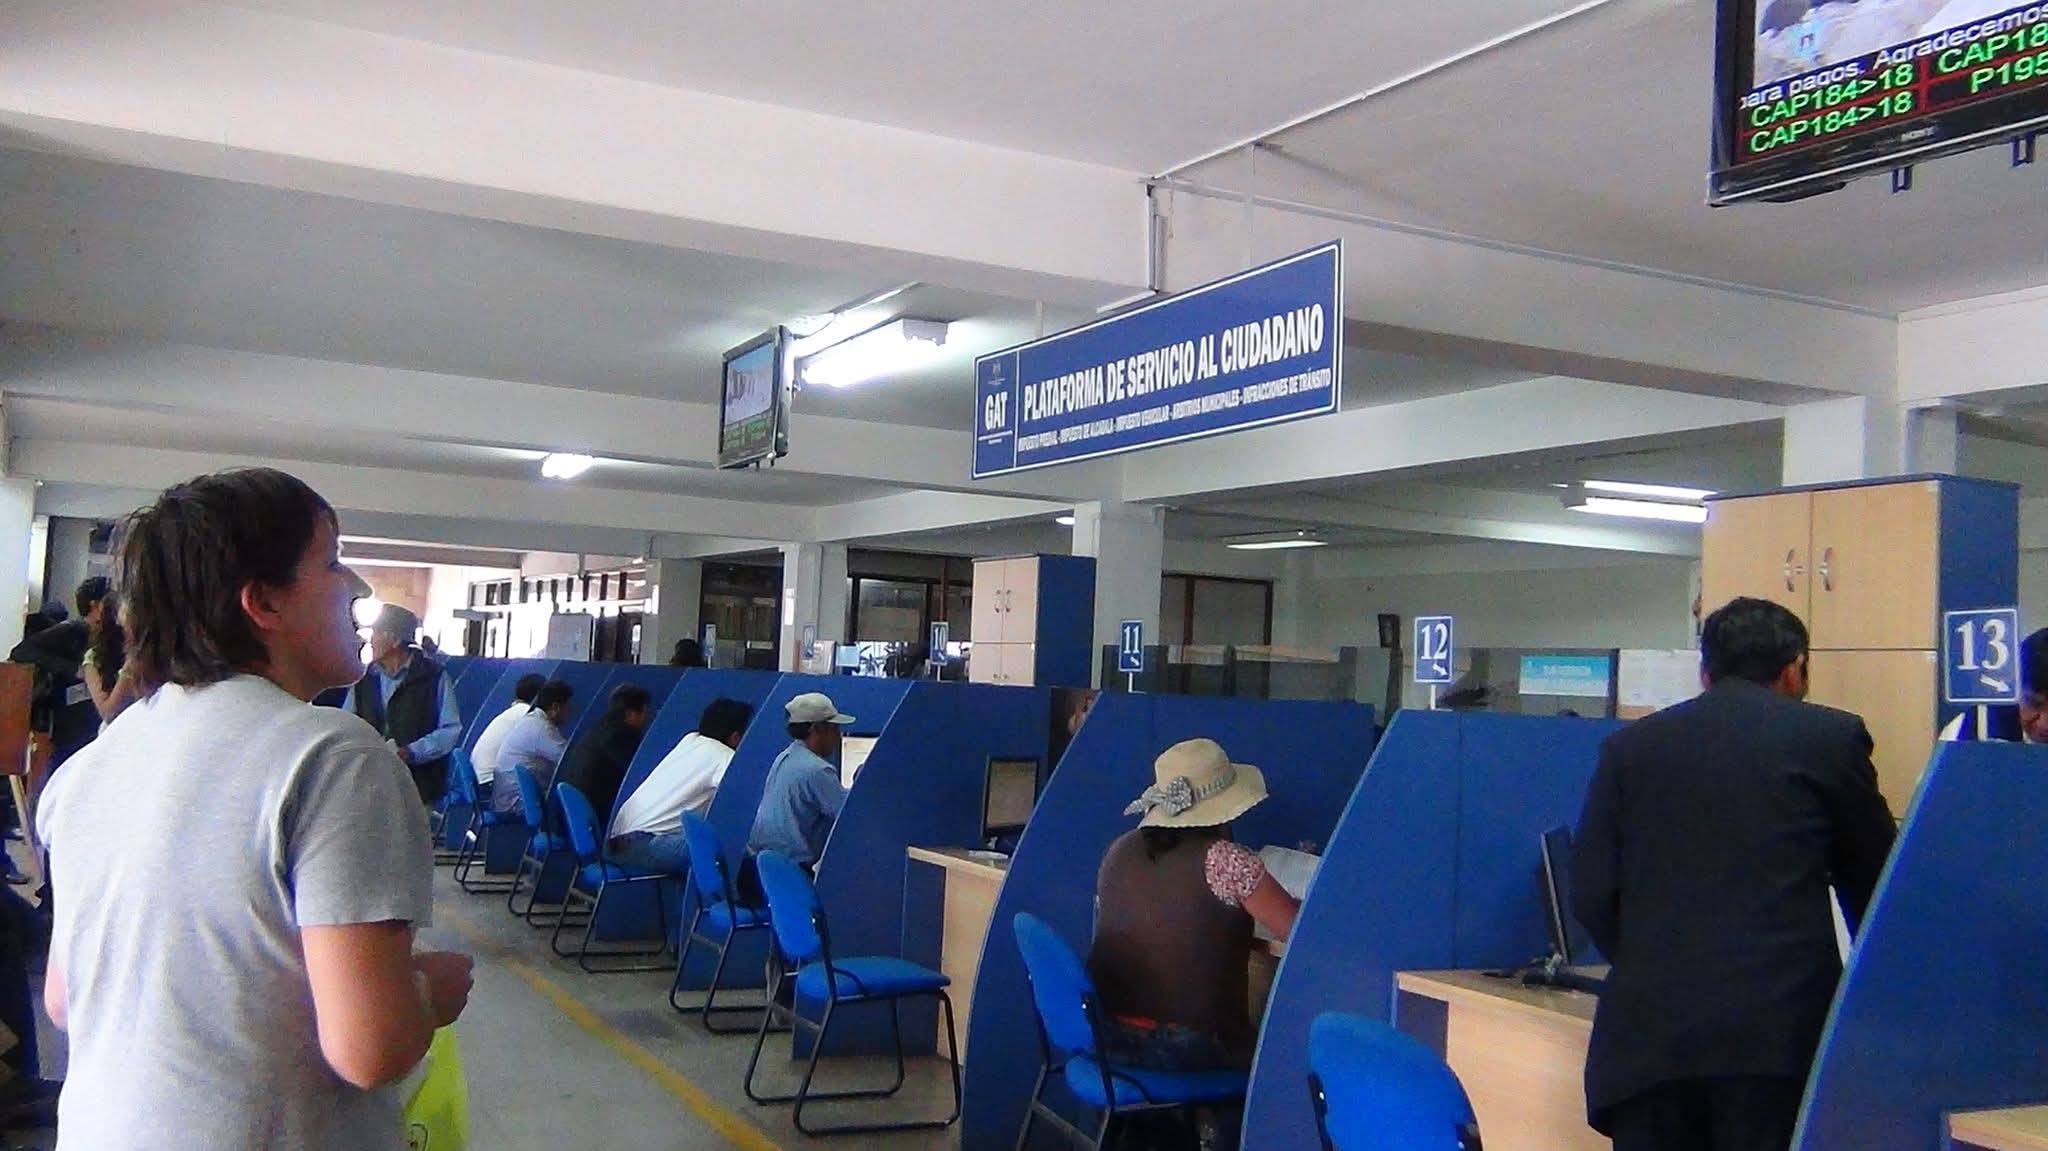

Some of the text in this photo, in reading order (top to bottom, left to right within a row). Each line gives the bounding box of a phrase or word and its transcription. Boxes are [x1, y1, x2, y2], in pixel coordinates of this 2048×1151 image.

[1938, 22, 2048, 73] CAP18
[1970, 51, 2048, 94] P195
[1751, 64, 1914, 127] CAP184>18
[1750, 91, 1913, 152] CAP184>18
[1024, 303, 1324, 422] PLATAFORMA DE SERVICIO AL CIUDADANO
[984, 391, 1008, 431] GAT
[1243, 377, 1288, 404] INFRACCIONES
[1289, 375, 1298, 394] DE
[934, 626, 946, 650] 10
[1123, 626, 1140, 654] 11
[1421, 623, 1448, 660] 12
[1956, 618, 2009, 670] 13
